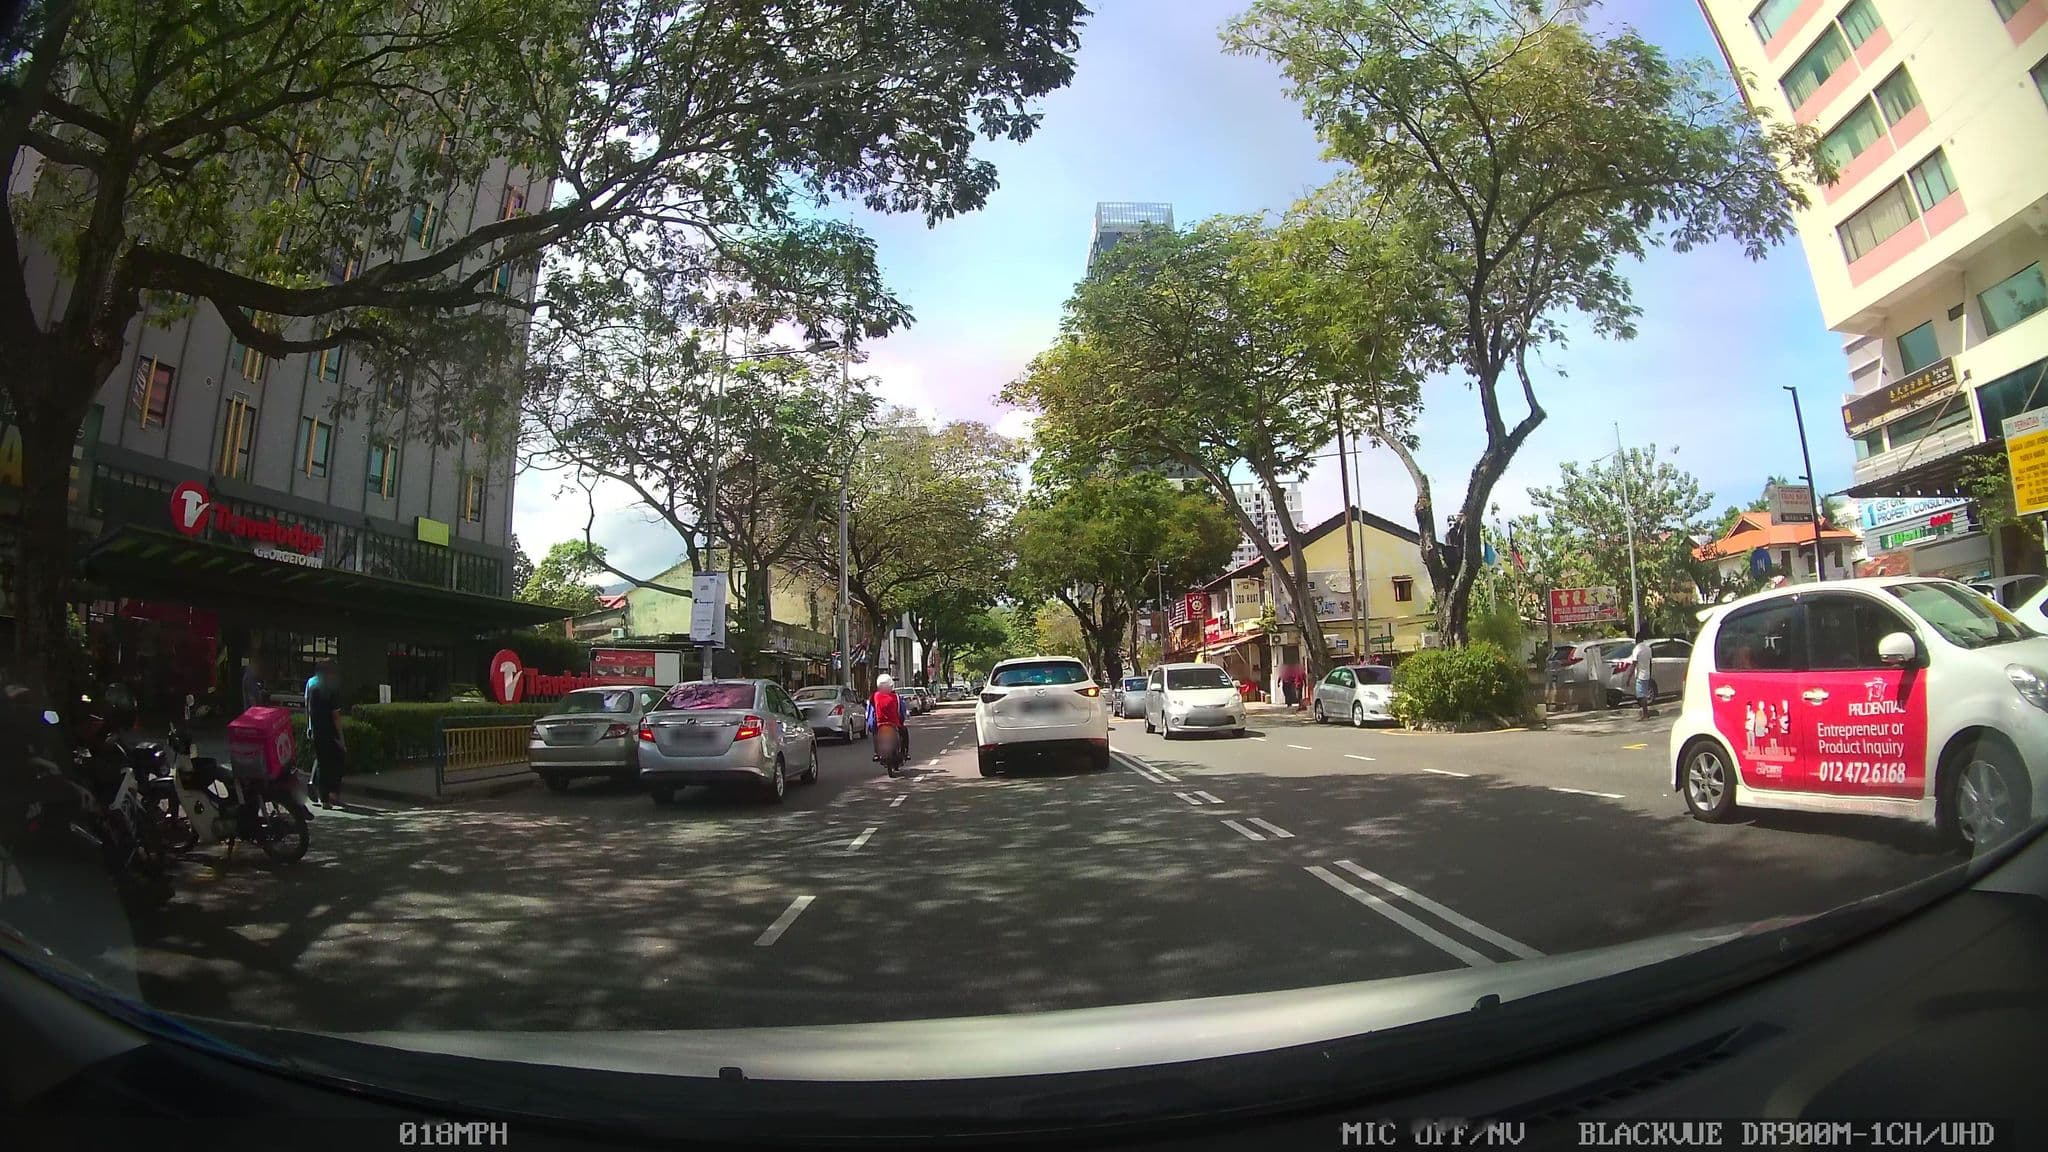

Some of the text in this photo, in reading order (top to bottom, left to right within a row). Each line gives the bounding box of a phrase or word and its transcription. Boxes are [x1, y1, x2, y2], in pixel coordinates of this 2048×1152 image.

[1877, 504, 1912, 522] PROPERTY
[215, 503, 324, 555] Travelodge
[254, 548, 323, 569] GEORGETOWN
[1848, 700, 1906, 717] PRUDENTIAL
[1817, 722, 1904, 740] Entrepreneur or
[1818, 738, 1904, 758] Product Inquiry
[1819, 761, 1906, 783] 012 472 6168
